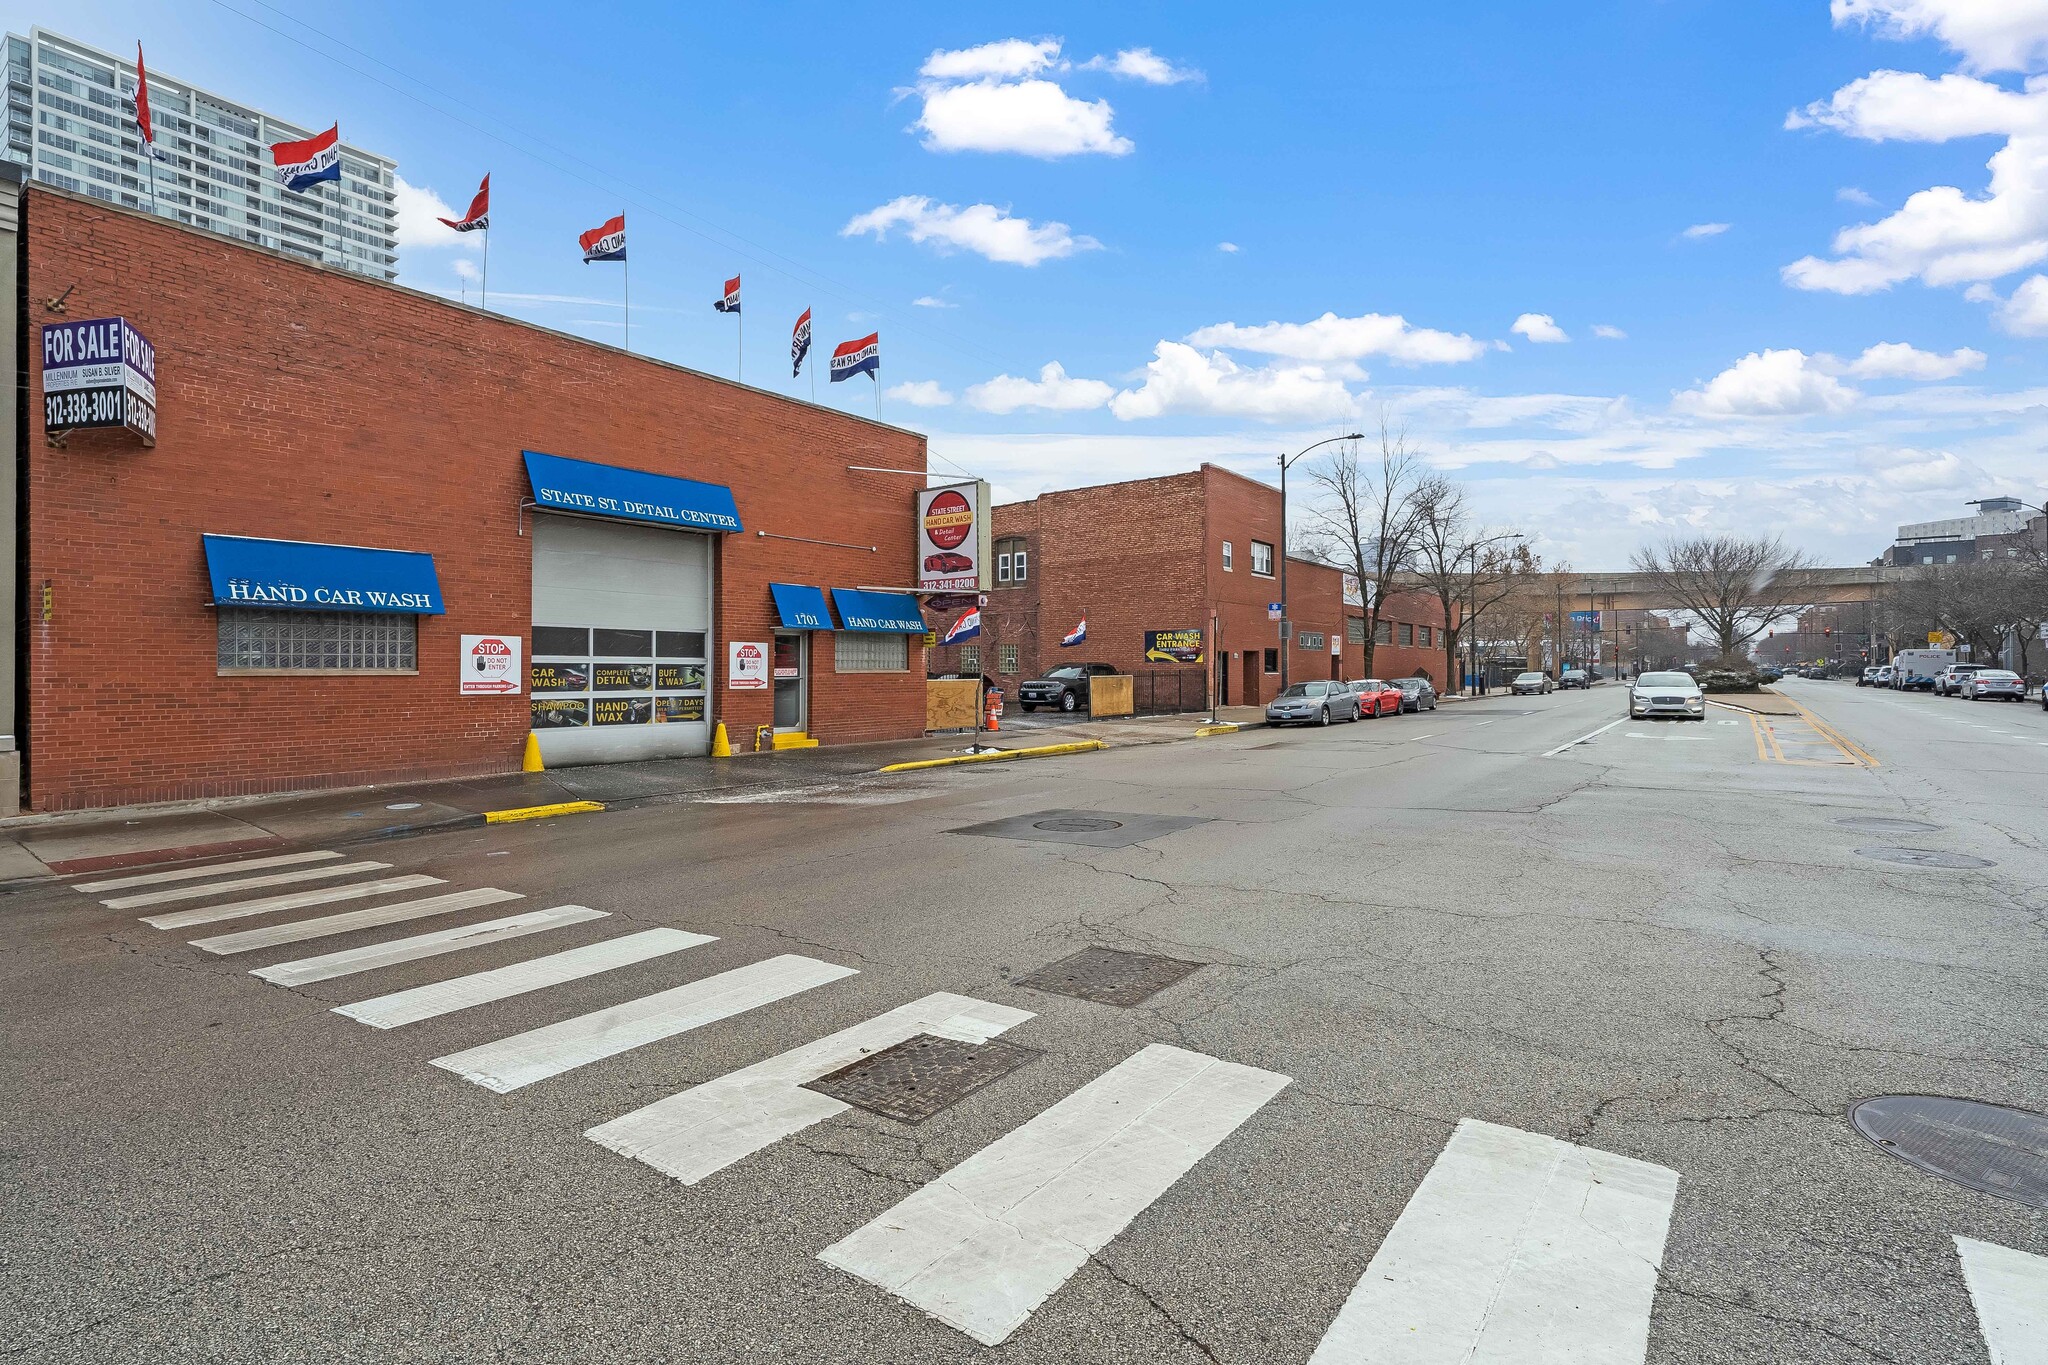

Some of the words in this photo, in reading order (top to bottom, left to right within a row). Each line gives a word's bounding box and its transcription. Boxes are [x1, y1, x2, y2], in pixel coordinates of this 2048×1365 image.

[45, 329, 74, 364] FOR
[77, 323, 119, 361] SALE
[124, 326, 141, 369] FOR
[140, 340, 155, 381] SALE
[45, 369, 78, 381] MILLENNIUM
[82, 367, 98, 378] SUSAN
[104, 365, 121, 376] SILVER
[46, 390, 121, 426] 312-338-3001
[540, 488, 596, 508] STATE
[597, 497, 621, 511] ST.
[624, 500, 679, 520] DETAIL
[680, 508, 738, 528] CENTER
[931, 507, 947, 516] STATE
[946, 504, 966, 514] STREET
[925, 517, 942, 527] HAND
[942, 516, 955, 525] CAR
[955, 514, 972, 524] WASH
[938, 528, 955, 536] Detail
[944, 534, 962, 542] Center
[923, 578, 975, 590] 312-341-0200
[228, 582, 308, 603] HAND
[314, 588, 363, 606] CAR
[365, 590, 433, 609] WASH
[794, 613, 820, 626] 1701
[847, 616, 877, 629] HAND
[877, 619, 898, 630] CAR
[897, 620, 923, 631] WASH
[1156, 633, 1173, 641] CAR
[1175, 632, 1201, 640] WASH
[478, 643, 505, 654] STOP
[1156, 640, 1201, 648] ENTRANCE
[740, 648, 758, 658] STOP
[531, 668, 555, 677] CAR
[658, 668, 678, 677] BUFF
[531, 678, 567, 687] WASH
[596, 676, 630, 685] DETAIL
[658, 677, 664, 686] &
[665, 677, 684, 686] WAX
[531, 701, 585, 711] SHAMPOO
[595, 701, 629, 712] HAND
[684, 698, 704, 706] DAYS
[595, 711, 623, 722] WAX
